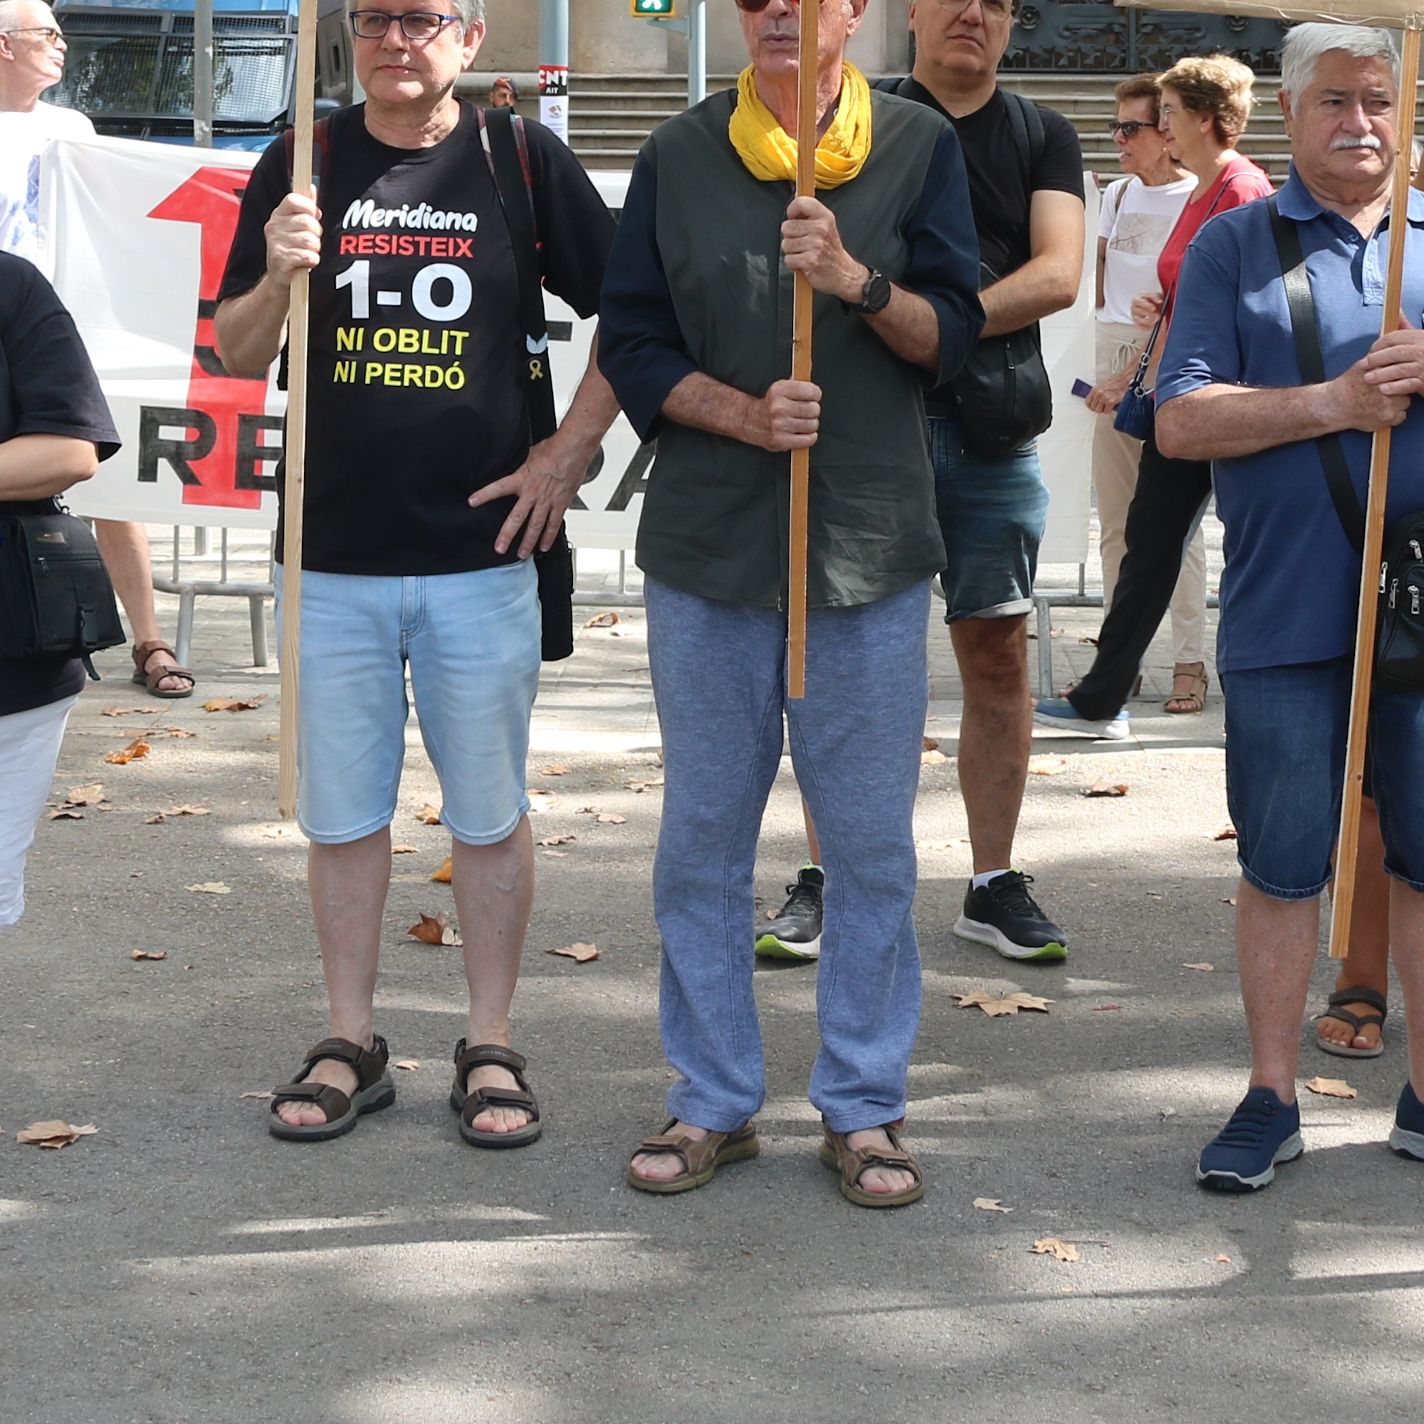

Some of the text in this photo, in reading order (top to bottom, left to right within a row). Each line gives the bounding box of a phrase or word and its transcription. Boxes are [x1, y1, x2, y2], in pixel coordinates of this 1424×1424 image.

[538, 69, 568, 86] CNT
[341, 198, 478, 233] Meridiana
[339, 234, 474, 259] RESISTEIX
[336, 326, 470, 357] NI OBLIT
[333, 360, 466, 391] NI PERDÓ
